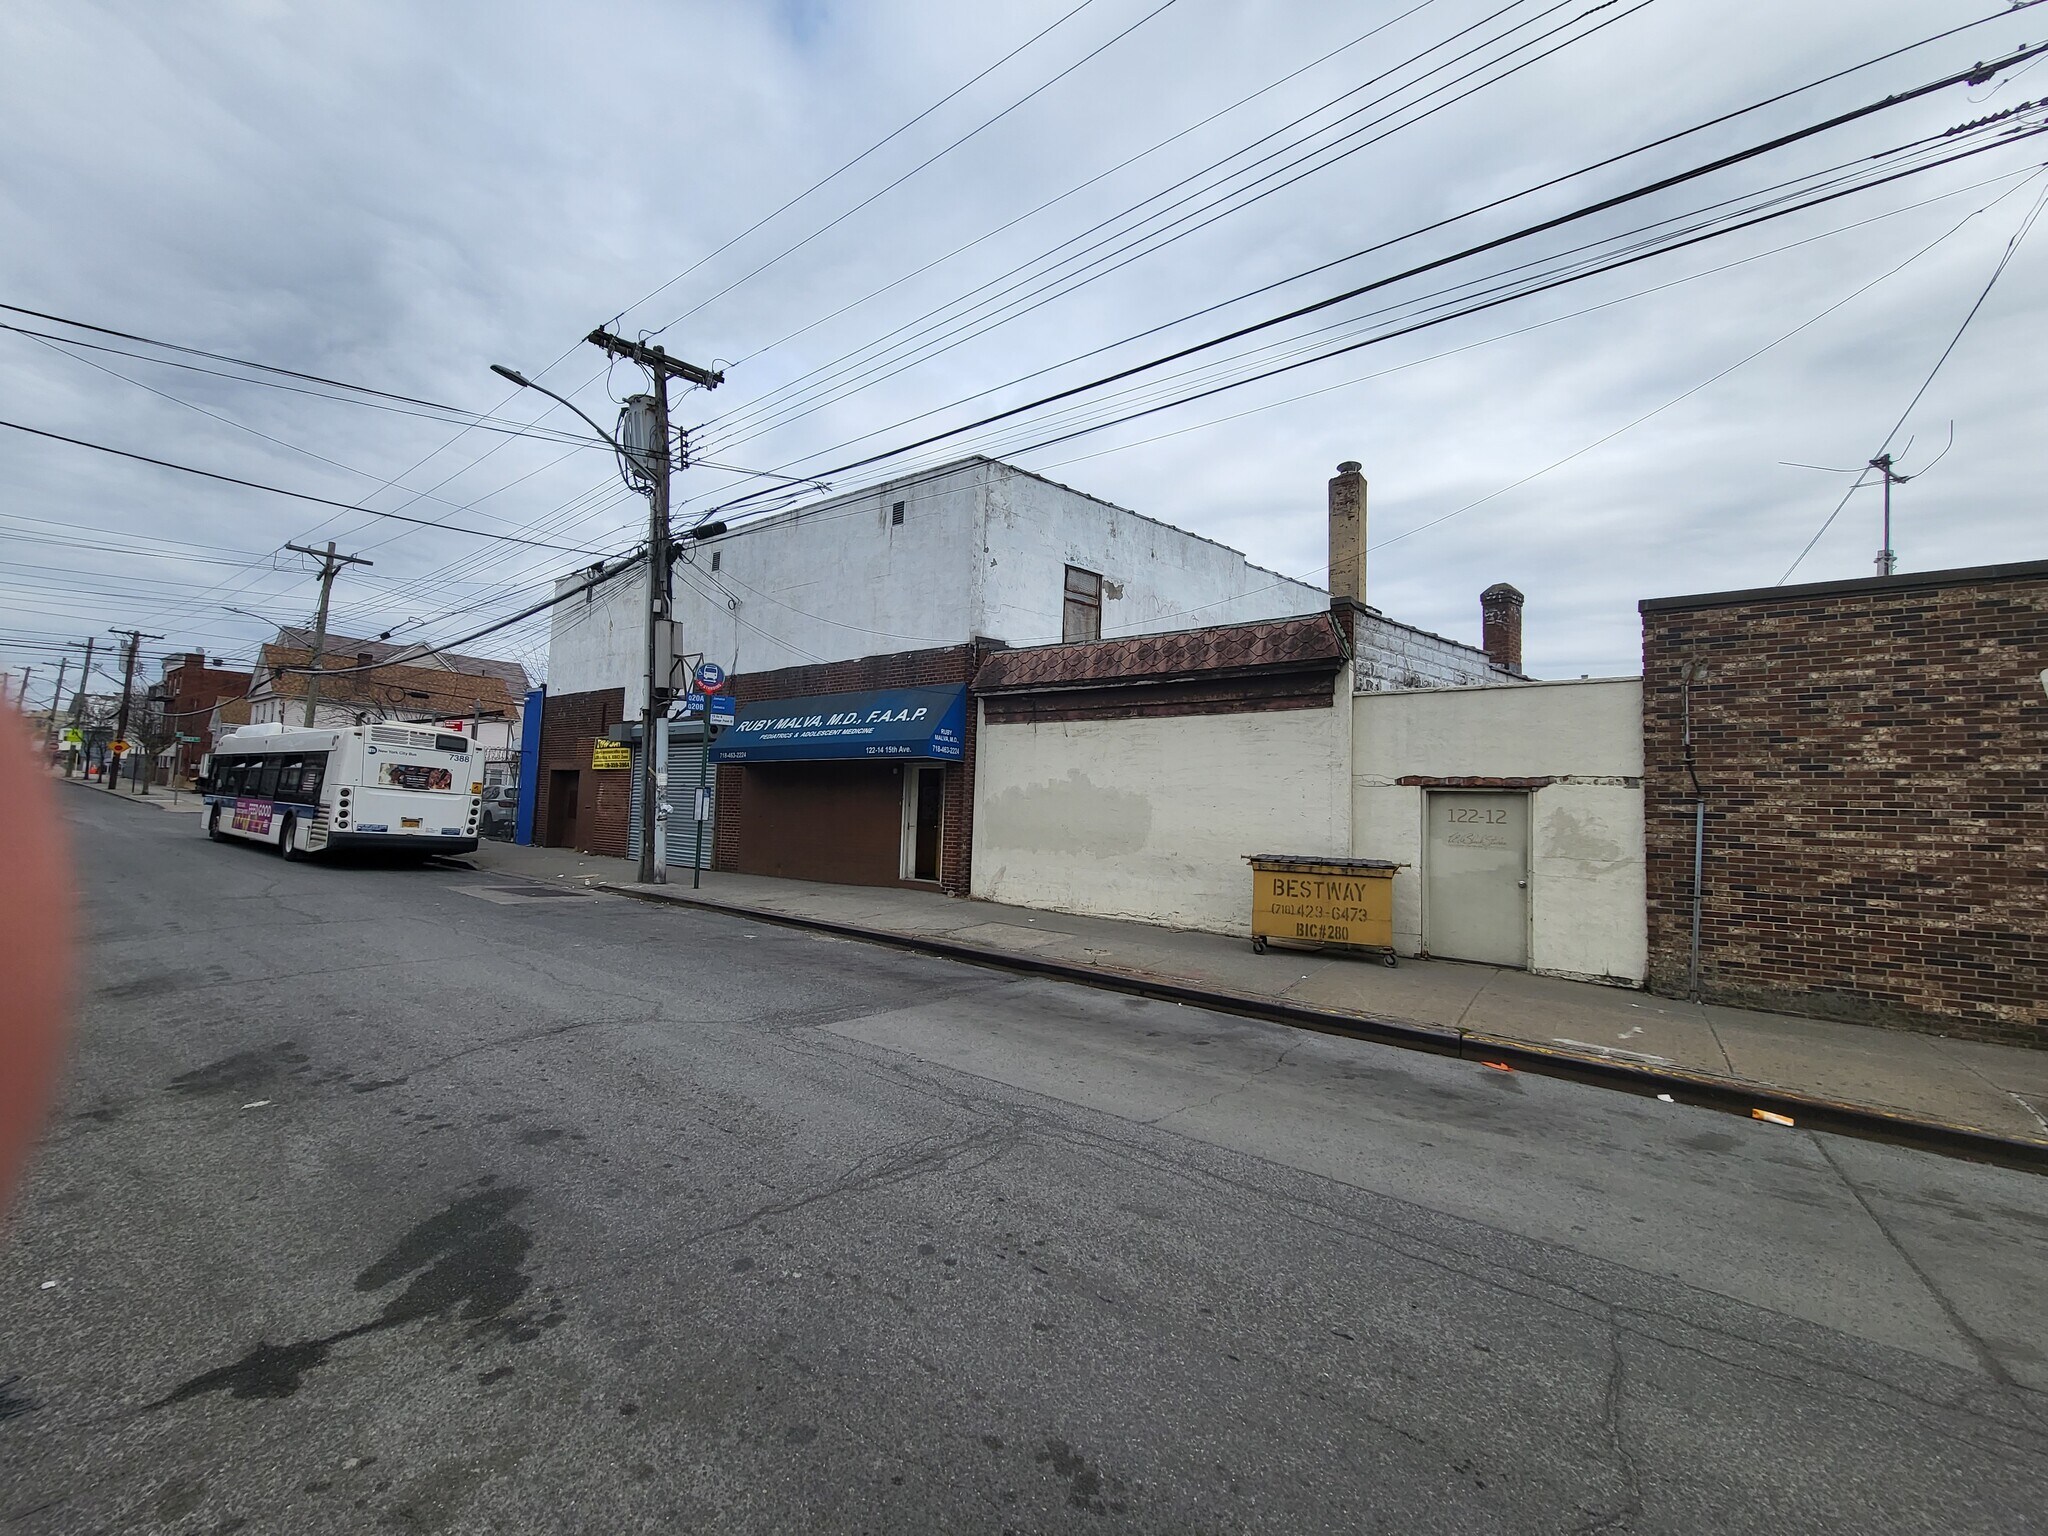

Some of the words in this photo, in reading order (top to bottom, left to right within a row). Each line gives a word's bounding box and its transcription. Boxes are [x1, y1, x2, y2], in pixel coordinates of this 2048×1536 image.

[735, 718, 777, 732] RUBY
[773, 715, 823, 730] MALVA,
[826, 712, 862, 726] M.D.,
[865, 707, 928, 723] F.A.A.P.
[759, 732, 794, 740] PEDIATRICS
[800, 729, 843, 738] ADOLESCENT
[842, 727, 875, 735] MEDICINE
[941, 728, 952, 736] RUBY
[449, 754, 470, 763] 7388
[1447, 808, 1508, 825] 122-12
[1273, 878, 1367, 902] BESTWAY
[1296, 922, 1349, 940] BIC#280
